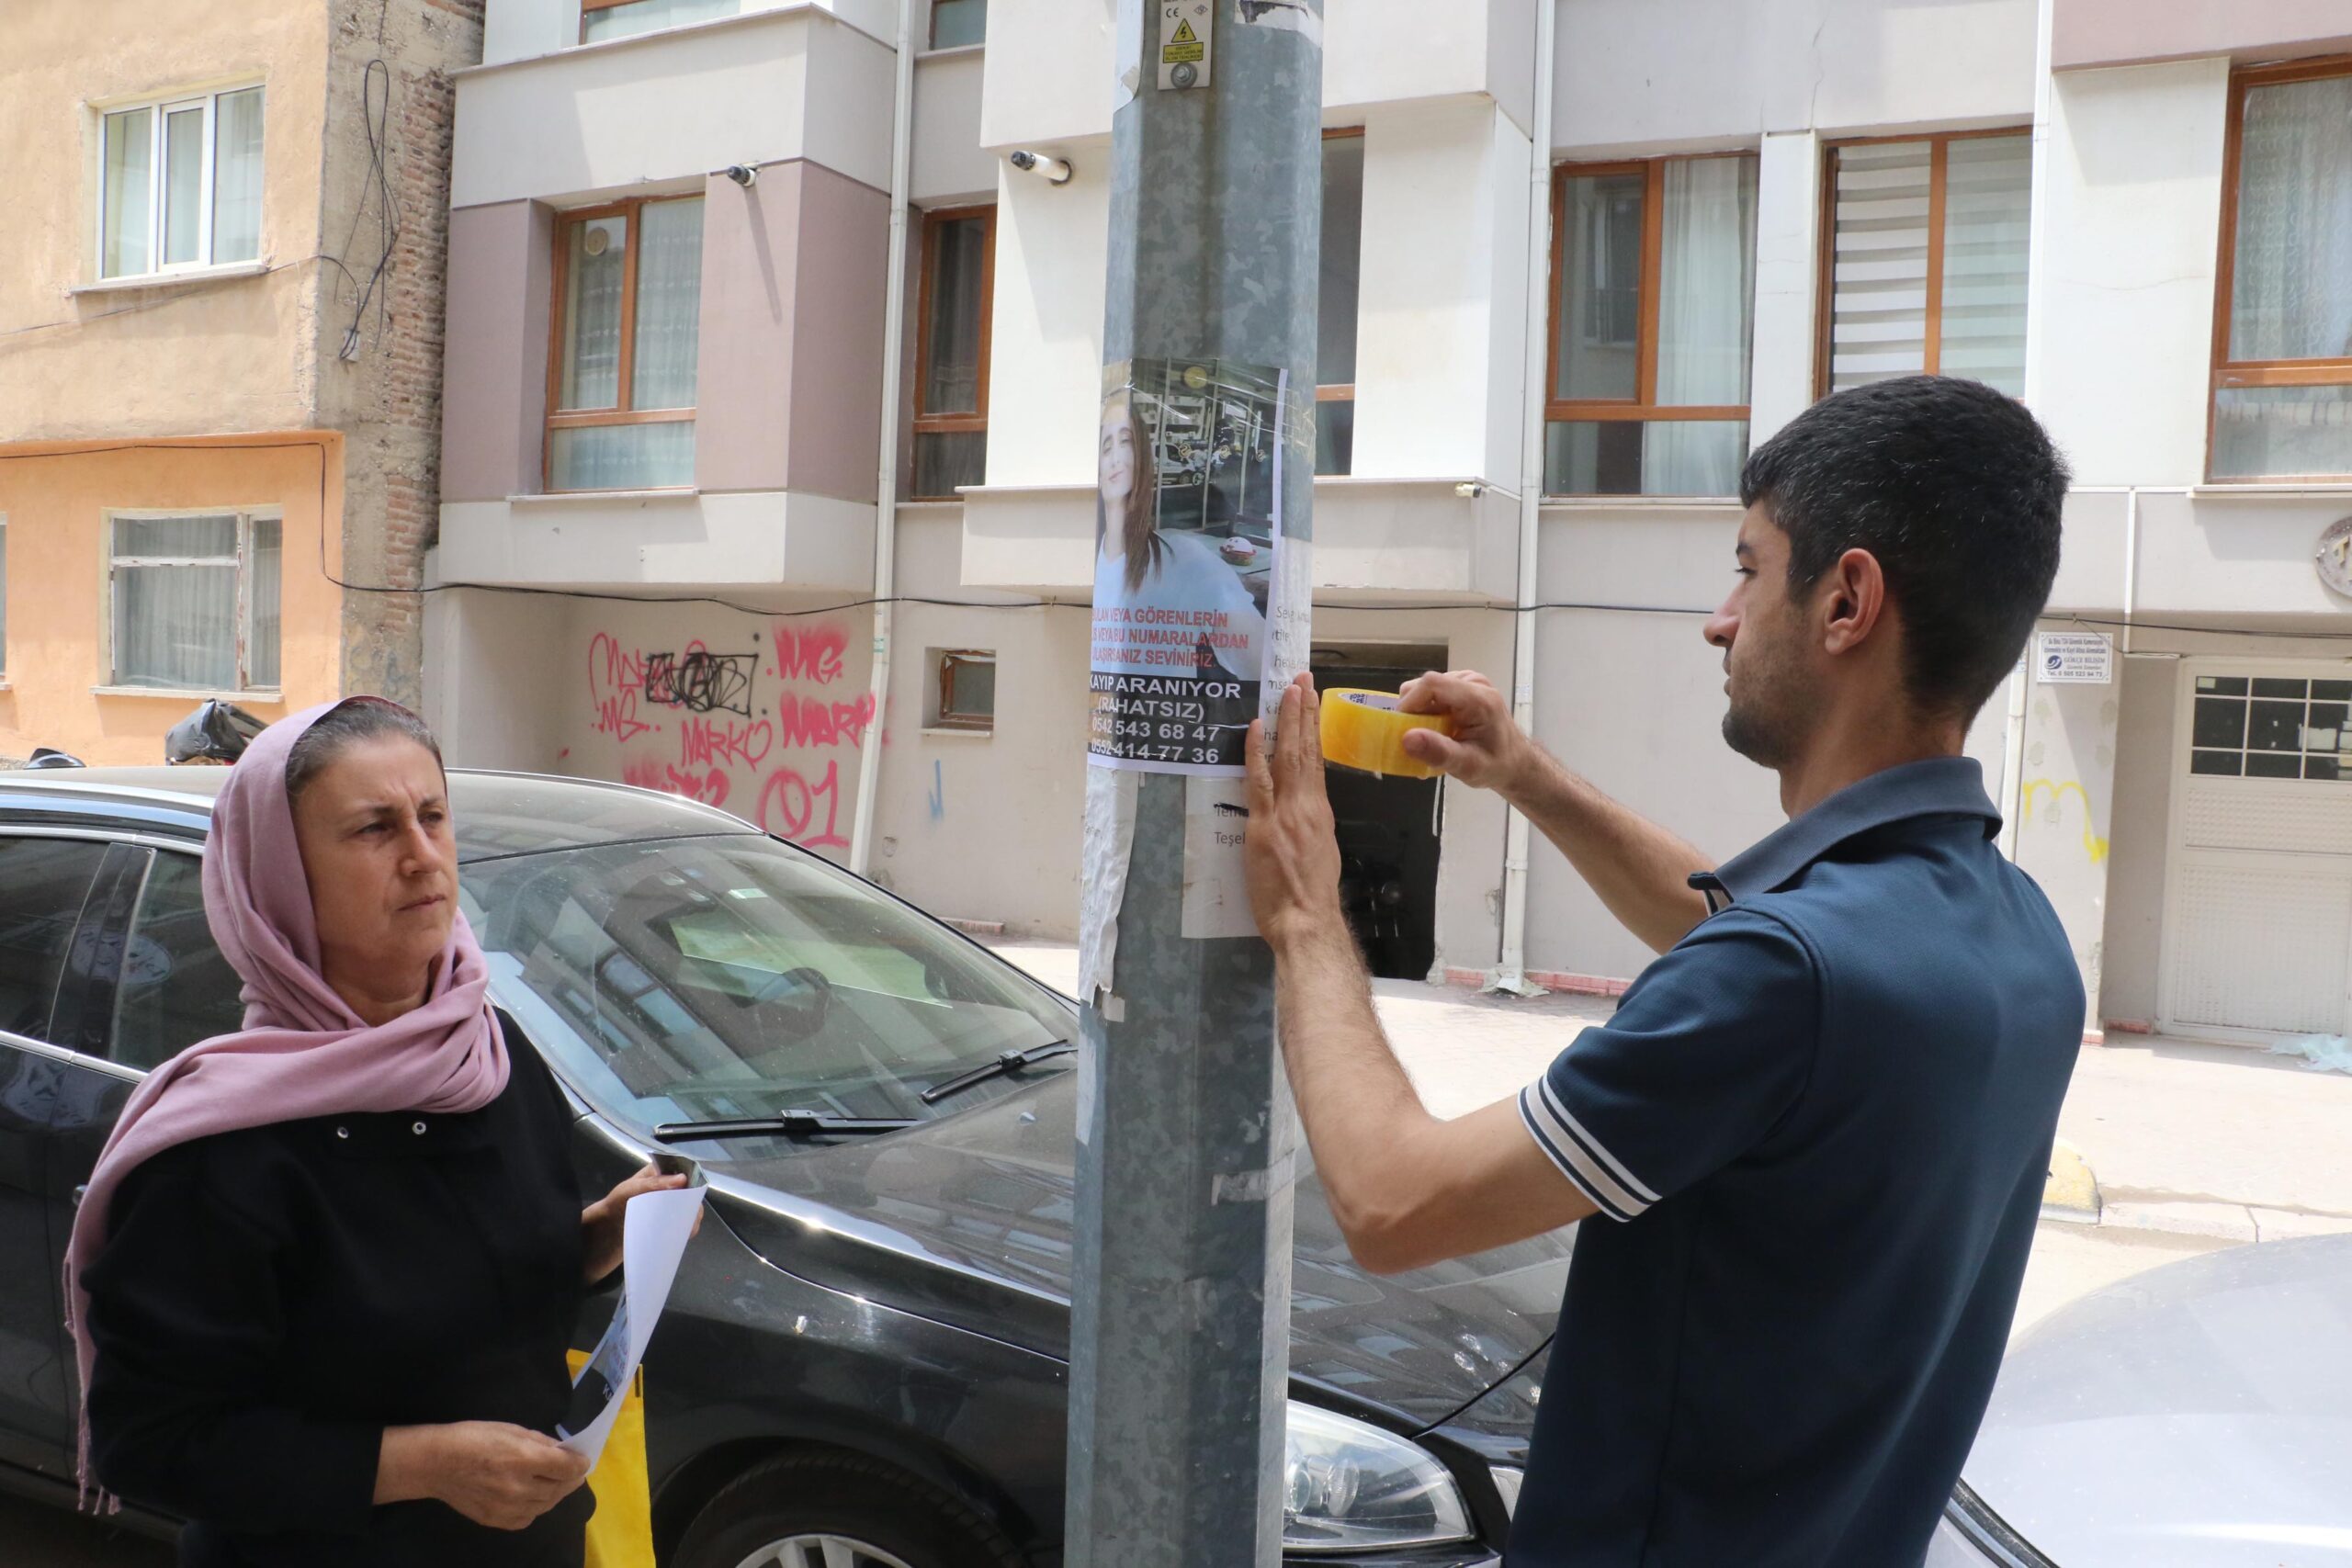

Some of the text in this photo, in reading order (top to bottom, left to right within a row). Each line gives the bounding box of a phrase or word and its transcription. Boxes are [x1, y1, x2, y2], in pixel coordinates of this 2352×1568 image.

[1135, 605, 1228, 627] GÖRENLERİN
[1129, 628, 1249, 649] NUMARALARDAN
[1115, 676, 1241, 699] ARANIYOR
[1098, 695, 1204, 724] (RAHATSIZ)
[1092, 716, 1220, 742] 0542 543 68 47
[1091, 738, 1220, 764] 0552 414 77 36
